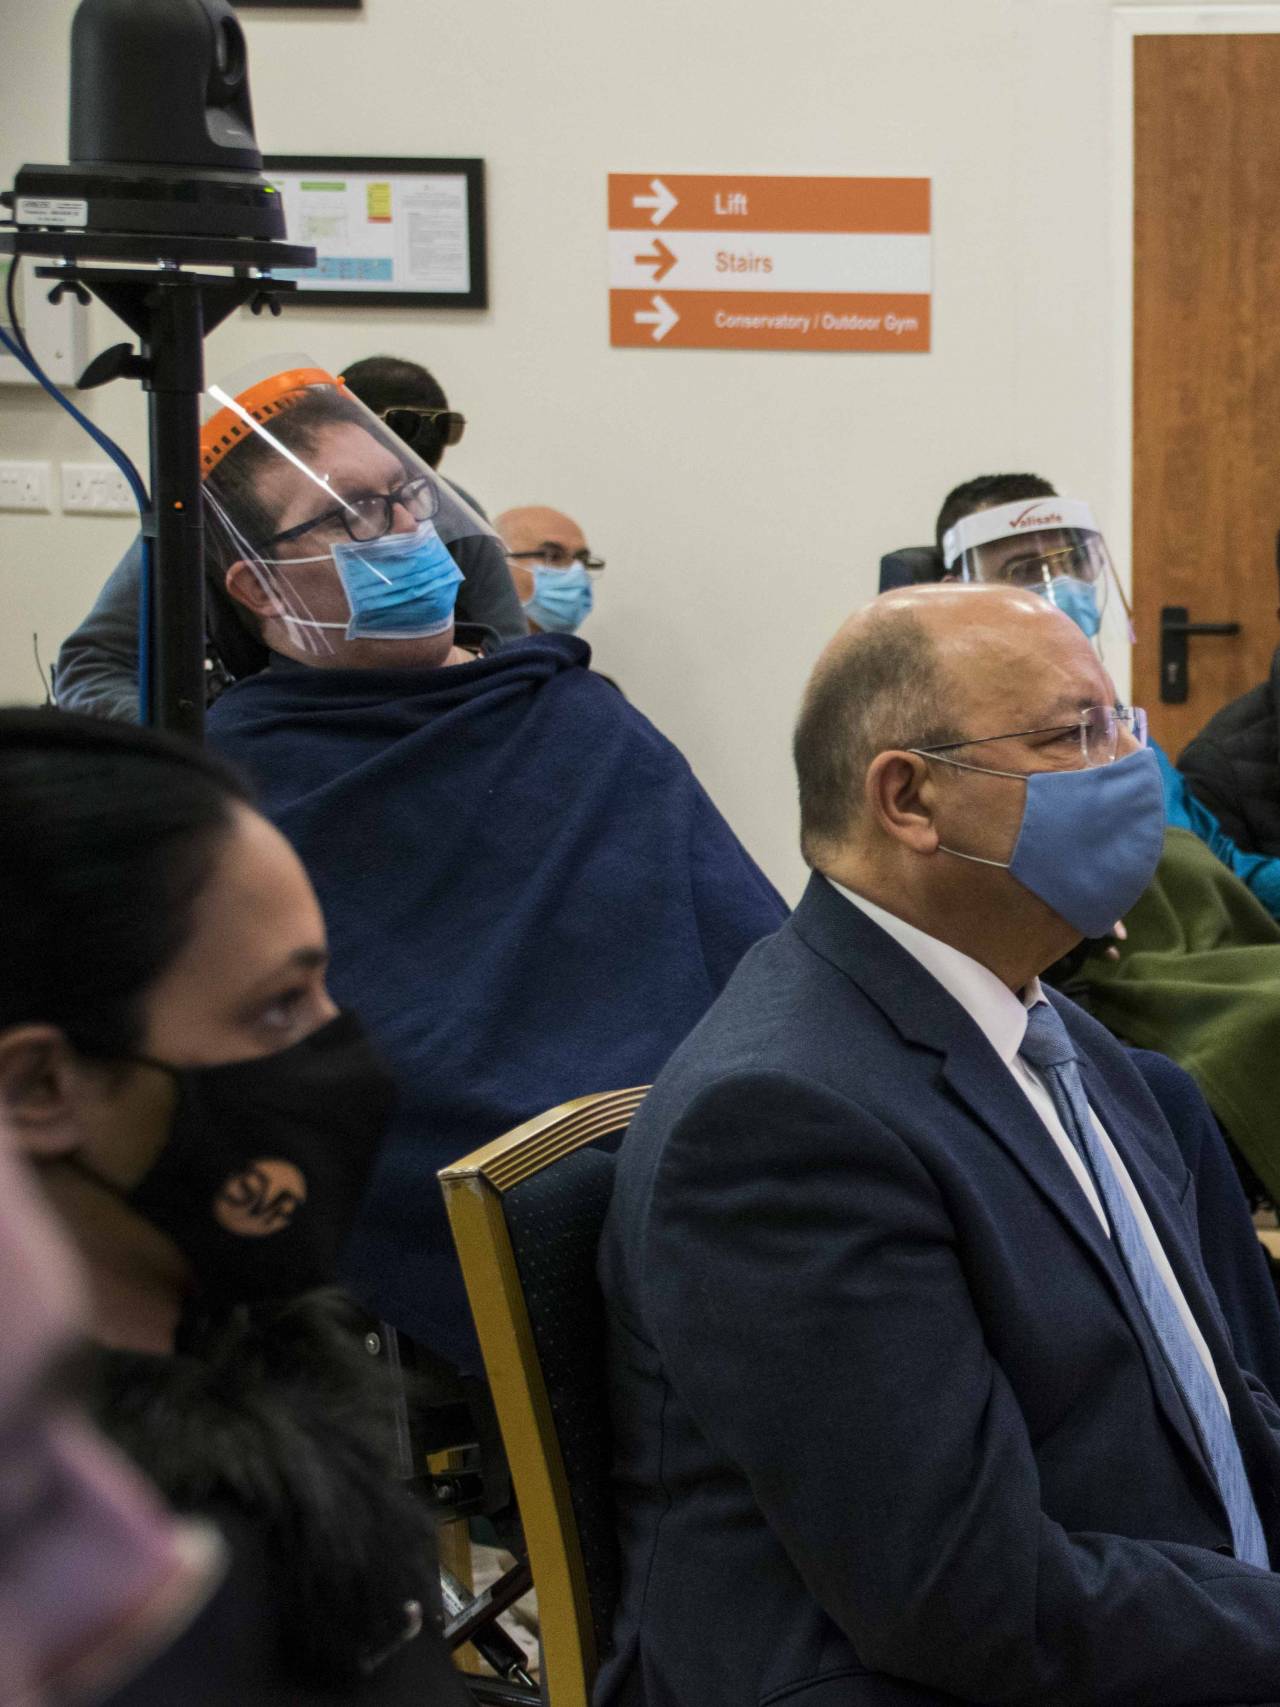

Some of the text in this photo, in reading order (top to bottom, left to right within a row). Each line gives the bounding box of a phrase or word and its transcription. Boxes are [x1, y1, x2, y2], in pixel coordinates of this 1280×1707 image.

[715, 193, 748, 215] Lift
[716, 252, 772, 273] Stairs
[715, 312, 809, 333] Conservatory
[821, 313, 881, 331] Outdoor
[885, 314, 918, 334] Gym
